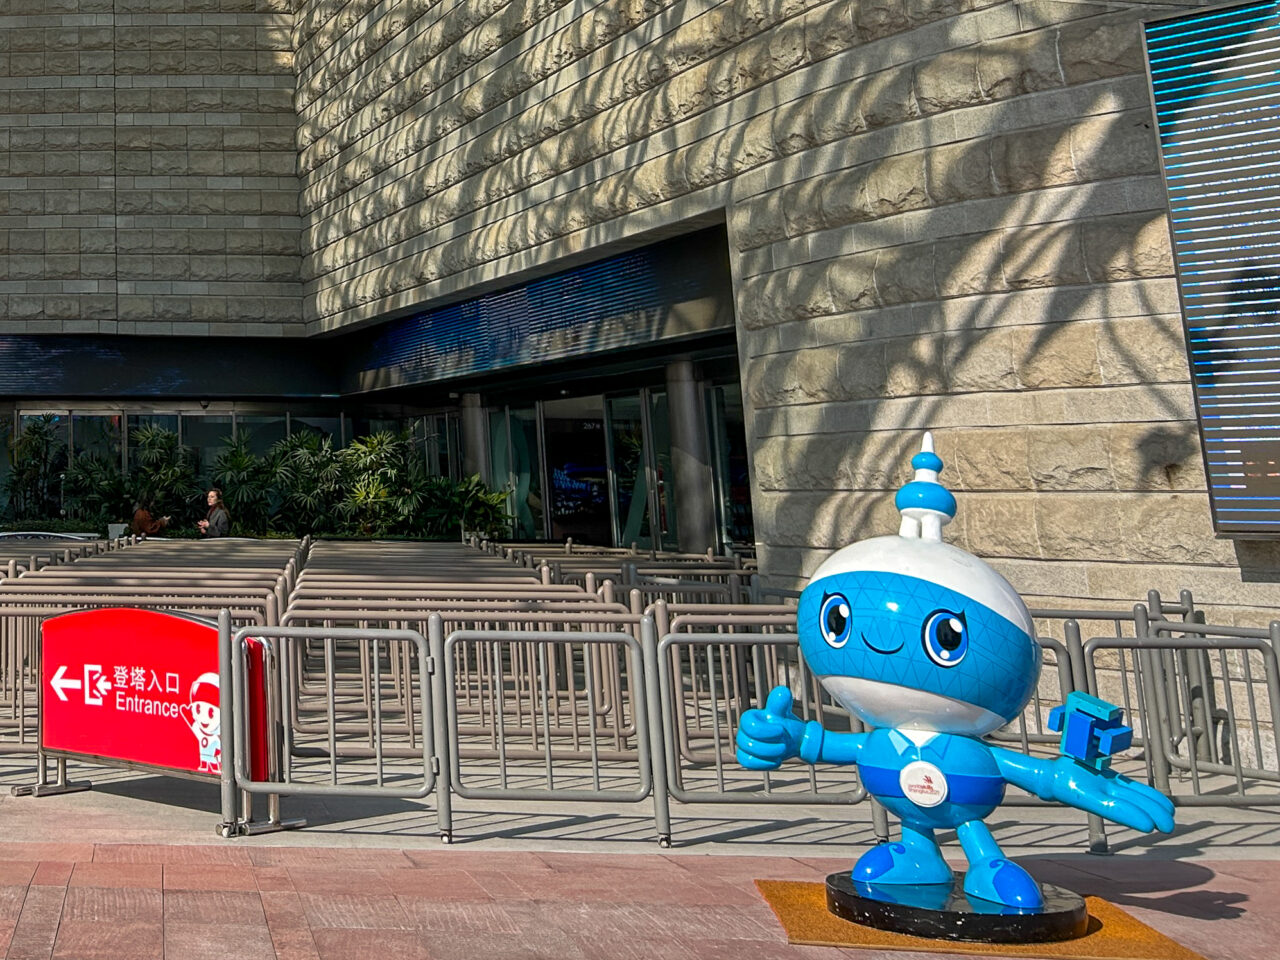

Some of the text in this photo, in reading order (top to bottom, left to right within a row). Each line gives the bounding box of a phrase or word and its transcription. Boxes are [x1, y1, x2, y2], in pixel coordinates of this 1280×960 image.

[113, 665, 180, 695] 登塔入口
[115, 690, 179, 718] Entrance
